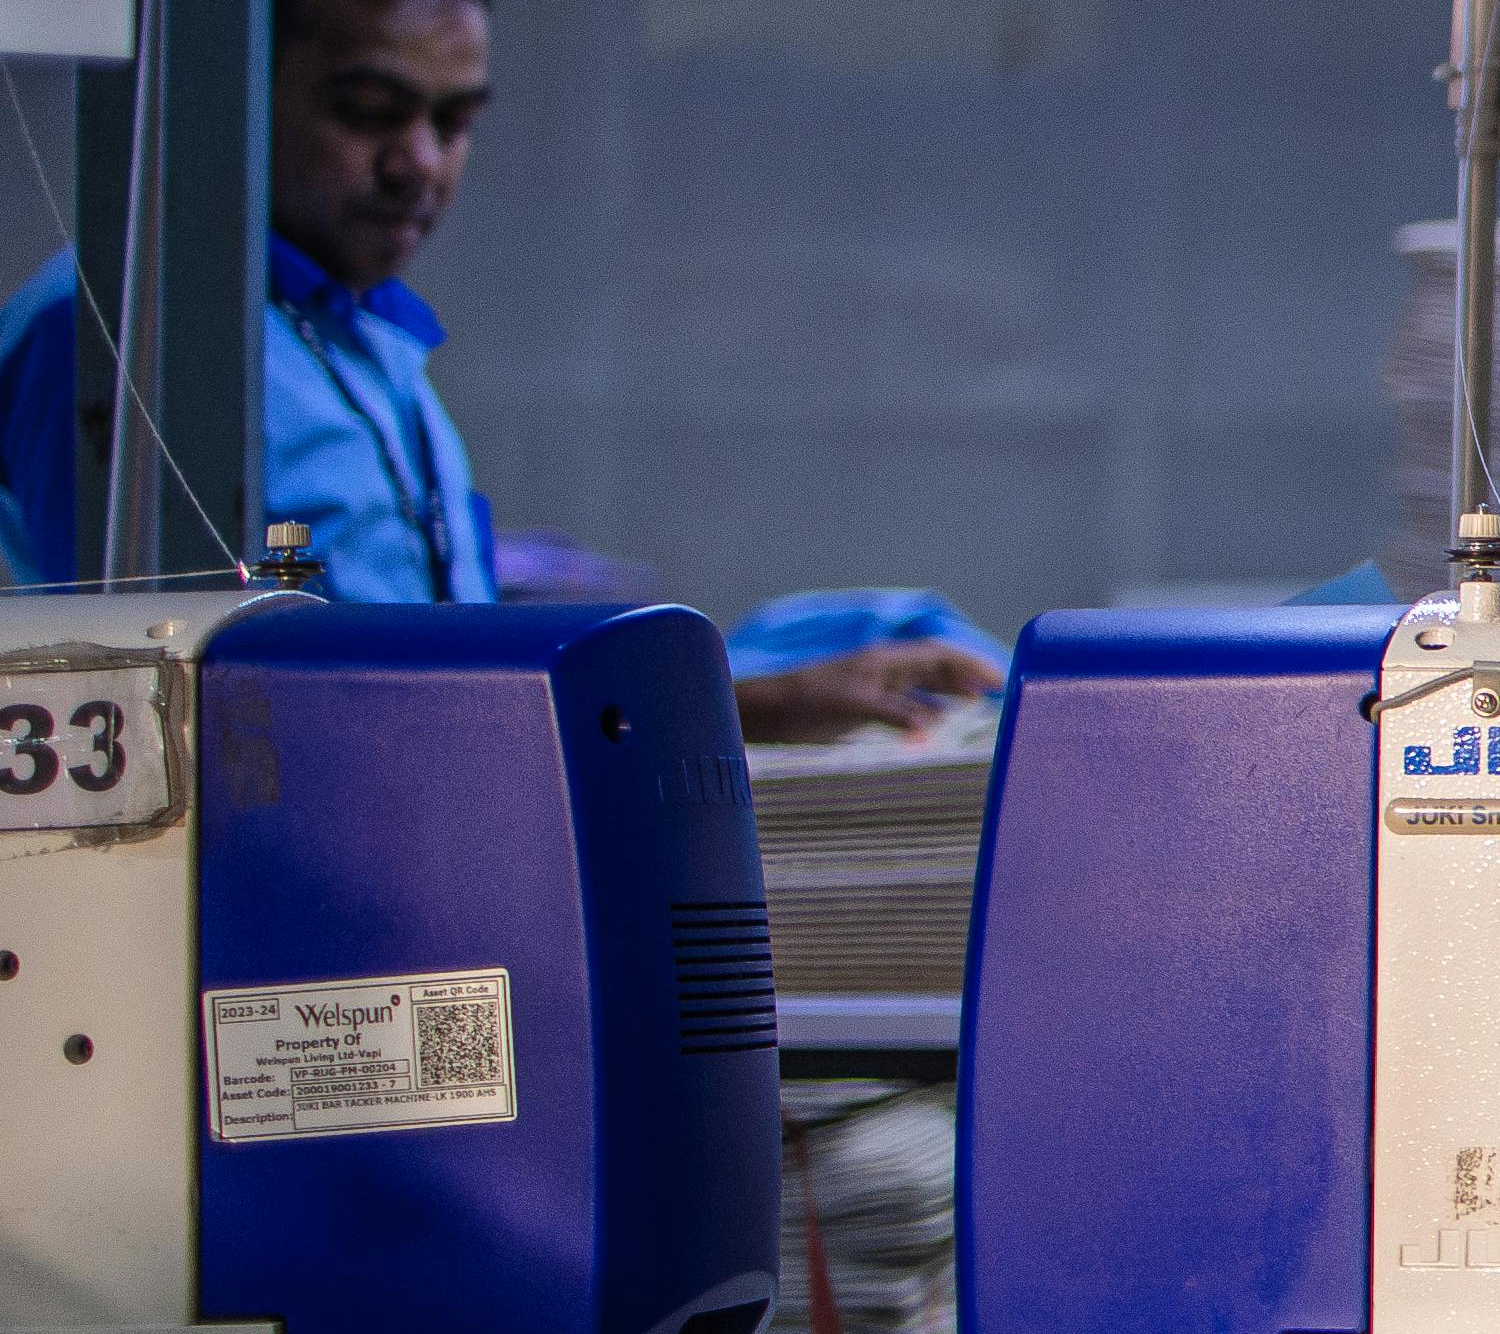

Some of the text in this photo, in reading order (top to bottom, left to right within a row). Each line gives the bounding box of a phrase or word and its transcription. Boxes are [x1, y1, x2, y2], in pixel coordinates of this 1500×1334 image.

[0, 701, 126, 795] 33
[1407, 804, 1464, 826] JUKI
[423, 986, 489, 998] Asset QR Code
[221, 1004, 276, 1019] 2023-24
[294, 1002, 393, 1031] Welspun
[275, 1033, 362, 1052] Property Of
[304, 1051, 335, 1063] Living
[223, 1073, 276, 1086] Barcode:
[222, 1090, 254, 1101] Asset
[257, 1087, 291, 1098] Code:
[296, 1101, 319, 1111] JUKI
[322, 1099, 342, 1110] BAR
[343, 1097, 382, 1108] TACKER
[450, 1090, 474, 1100] 1900
[223, 1113, 294, 1126] Description:
